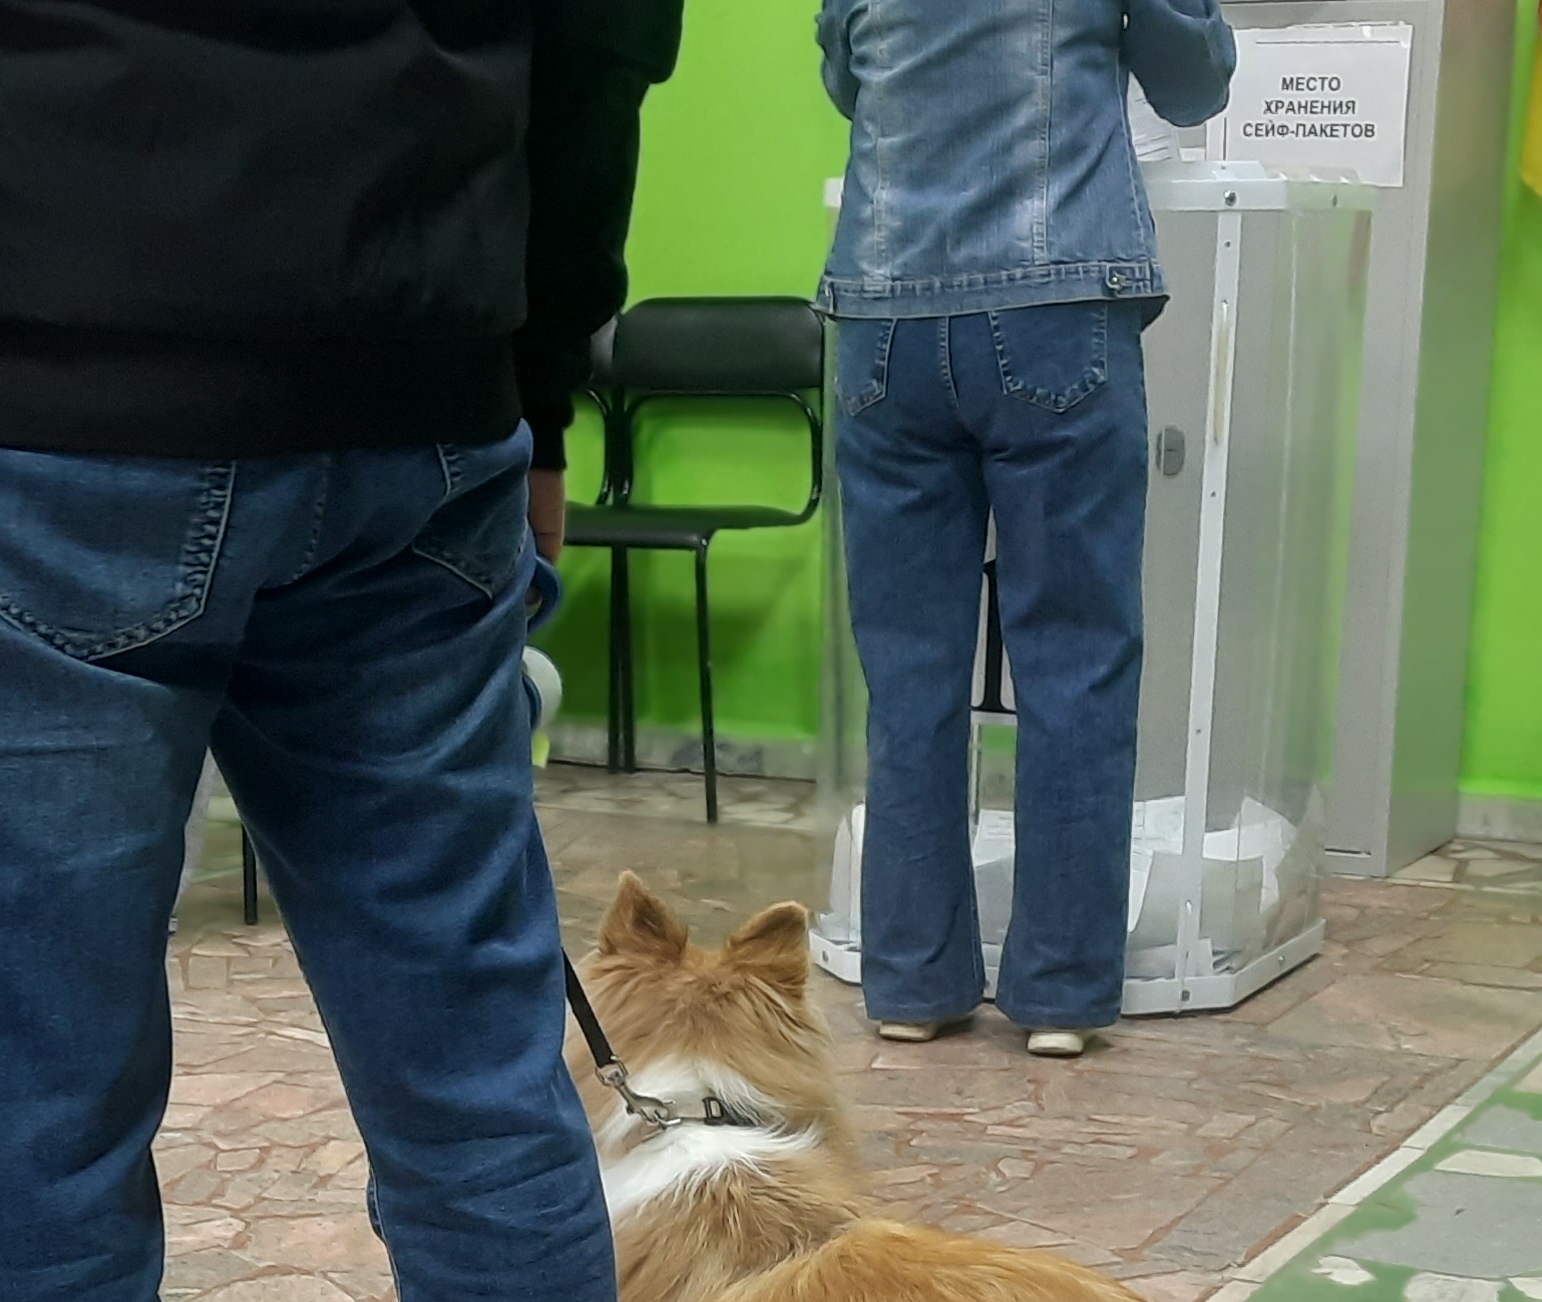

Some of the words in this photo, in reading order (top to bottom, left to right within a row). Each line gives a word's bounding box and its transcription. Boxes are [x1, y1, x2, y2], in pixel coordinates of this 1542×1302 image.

[1280, 76, 1342, 92] МЕСТО
[1262, 100, 1356, 115] ХРАНЕНИЯ
[1242, 120, 1376, 138] СЕЙФ-ПАКЕТОВ
